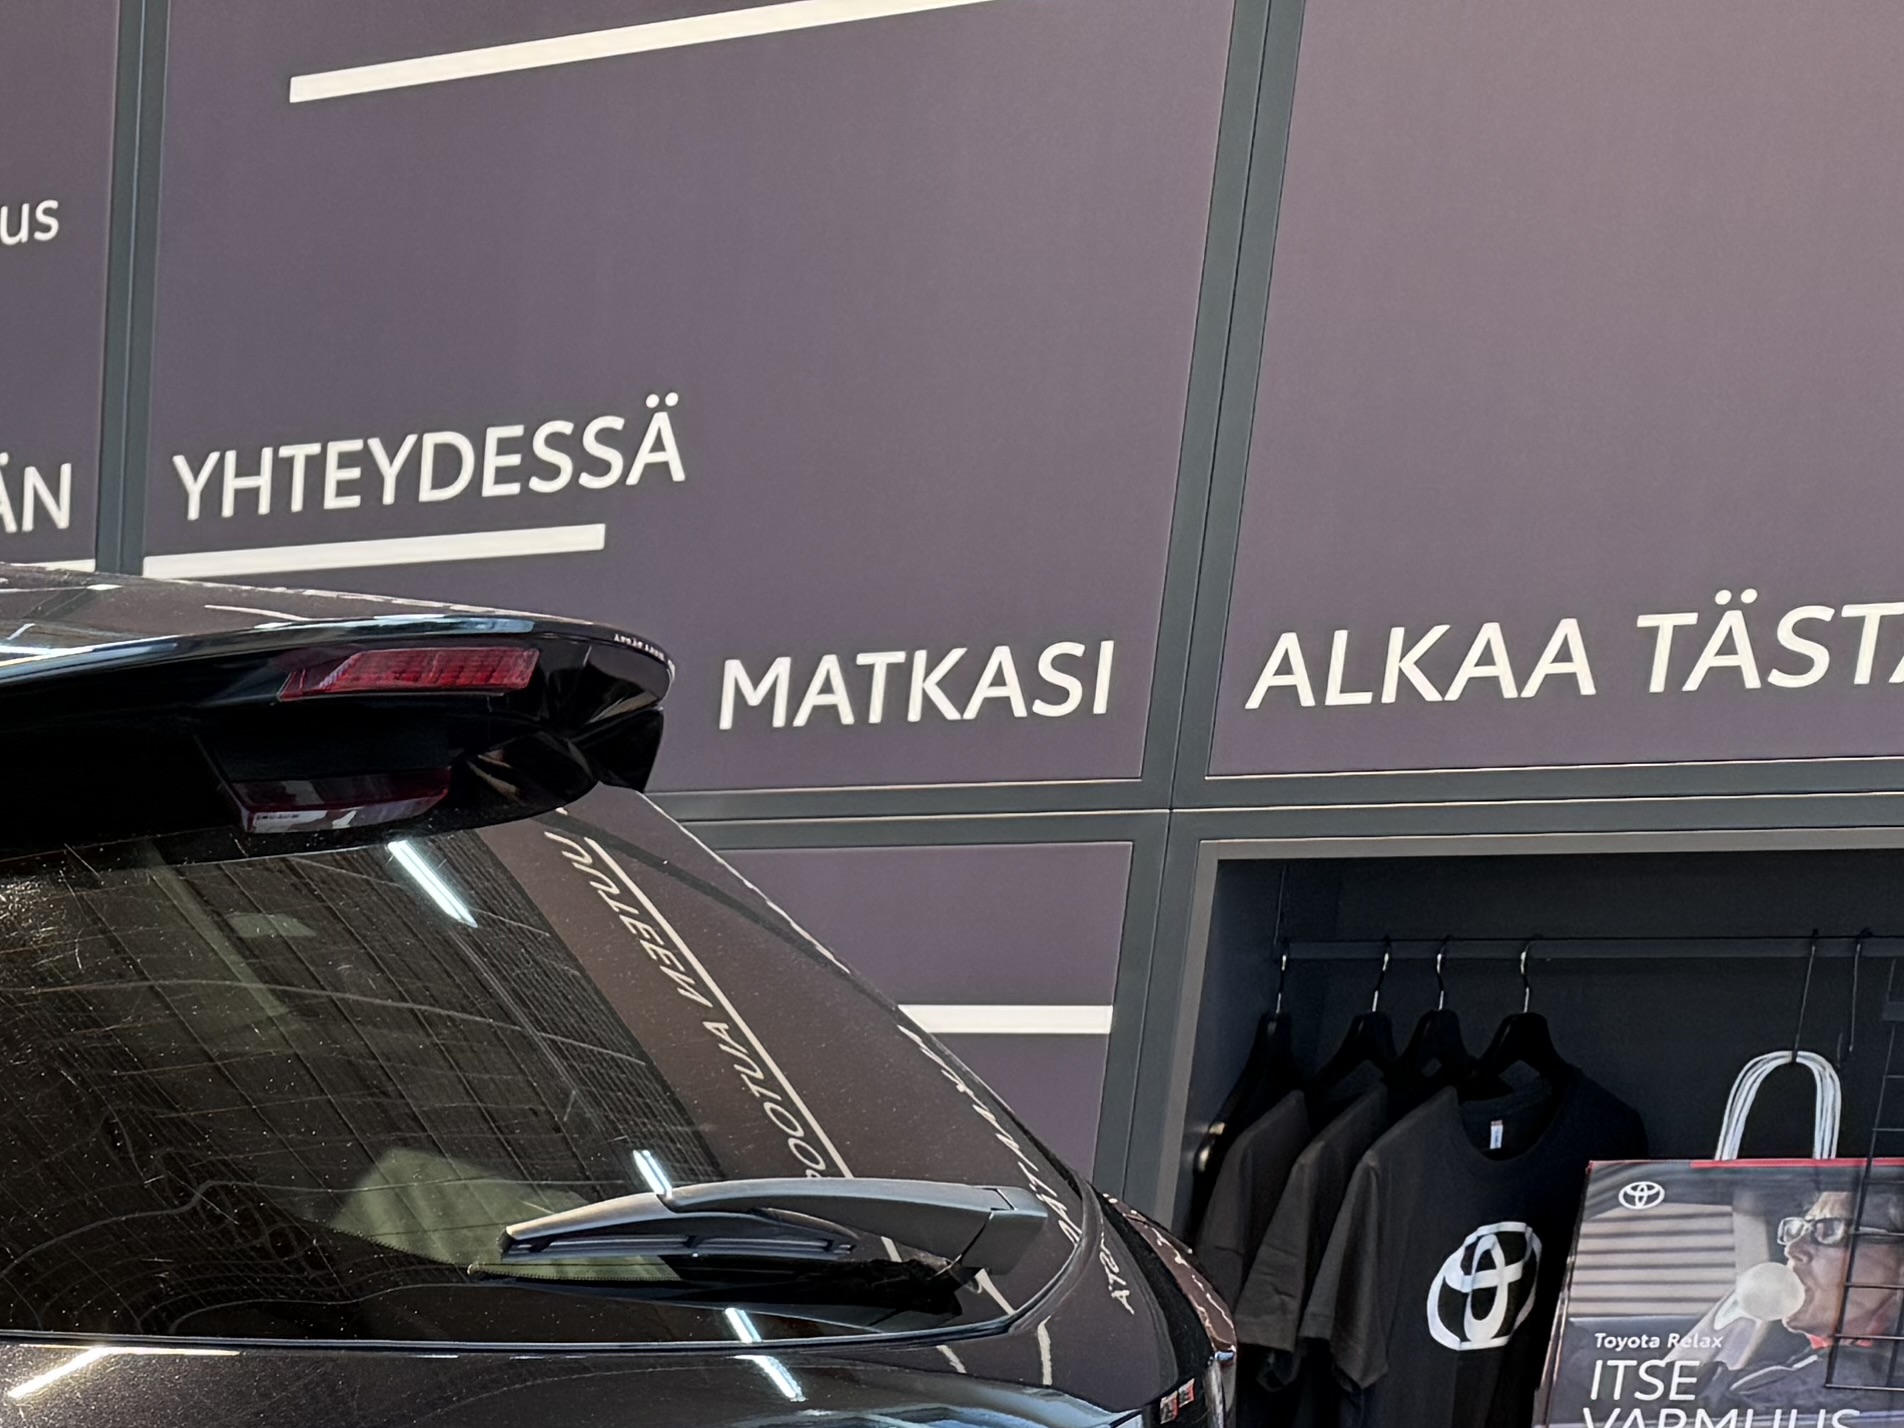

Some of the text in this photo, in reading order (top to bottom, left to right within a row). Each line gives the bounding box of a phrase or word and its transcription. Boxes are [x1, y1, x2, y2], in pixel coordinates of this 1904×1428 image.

[172, 391, 686, 521] YHTEYDESSÄ
[719, 640, 1115, 730] MATKASI
[1244, 618, 1597, 710] ALKAA
[1590, 1358, 1701, 1401] ITSE
[1594, 1332, 1724, 1353] Toyota Relax
